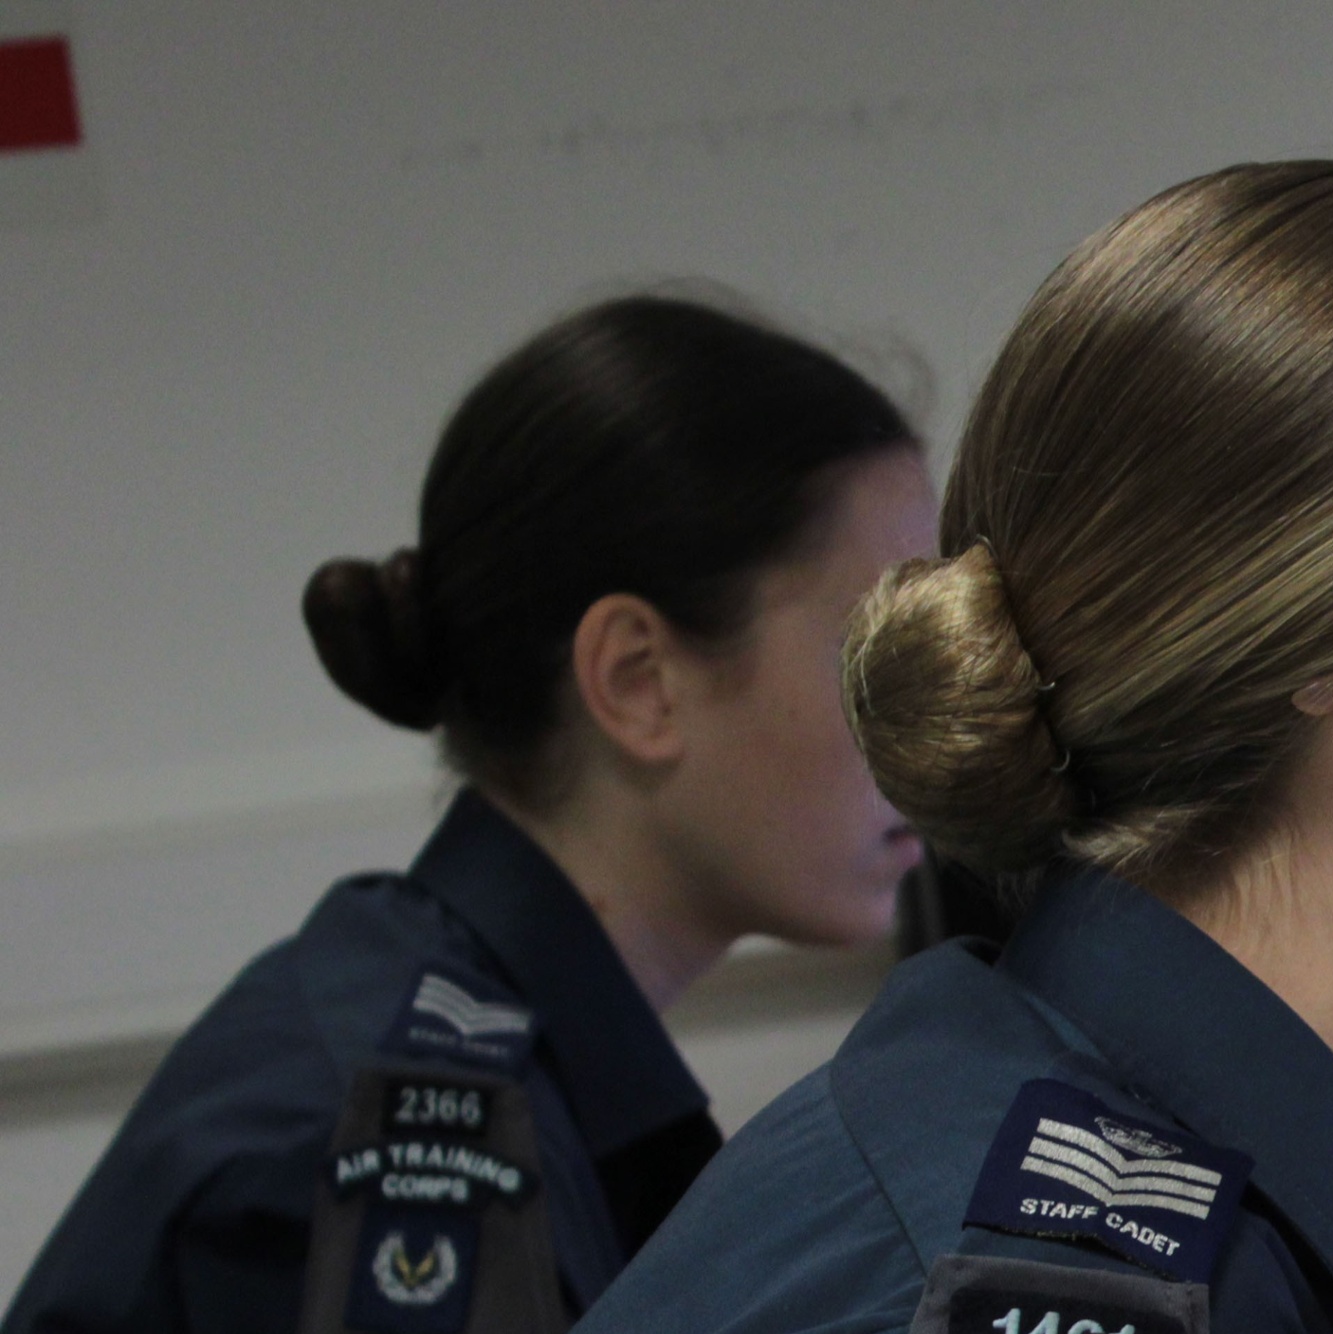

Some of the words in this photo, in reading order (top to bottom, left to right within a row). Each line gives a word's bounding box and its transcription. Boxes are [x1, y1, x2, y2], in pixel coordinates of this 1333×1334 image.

[395, 1087, 482, 1129] 2366
[337, 1147, 380, 1184] AIR
[389, 1142, 522, 1193] TRAINING
[382, 1174, 468, 1203] CORPS
[1020, 1197, 1098, 1224] STAFF
[1104, 1210, 1181, 1257] CADET
